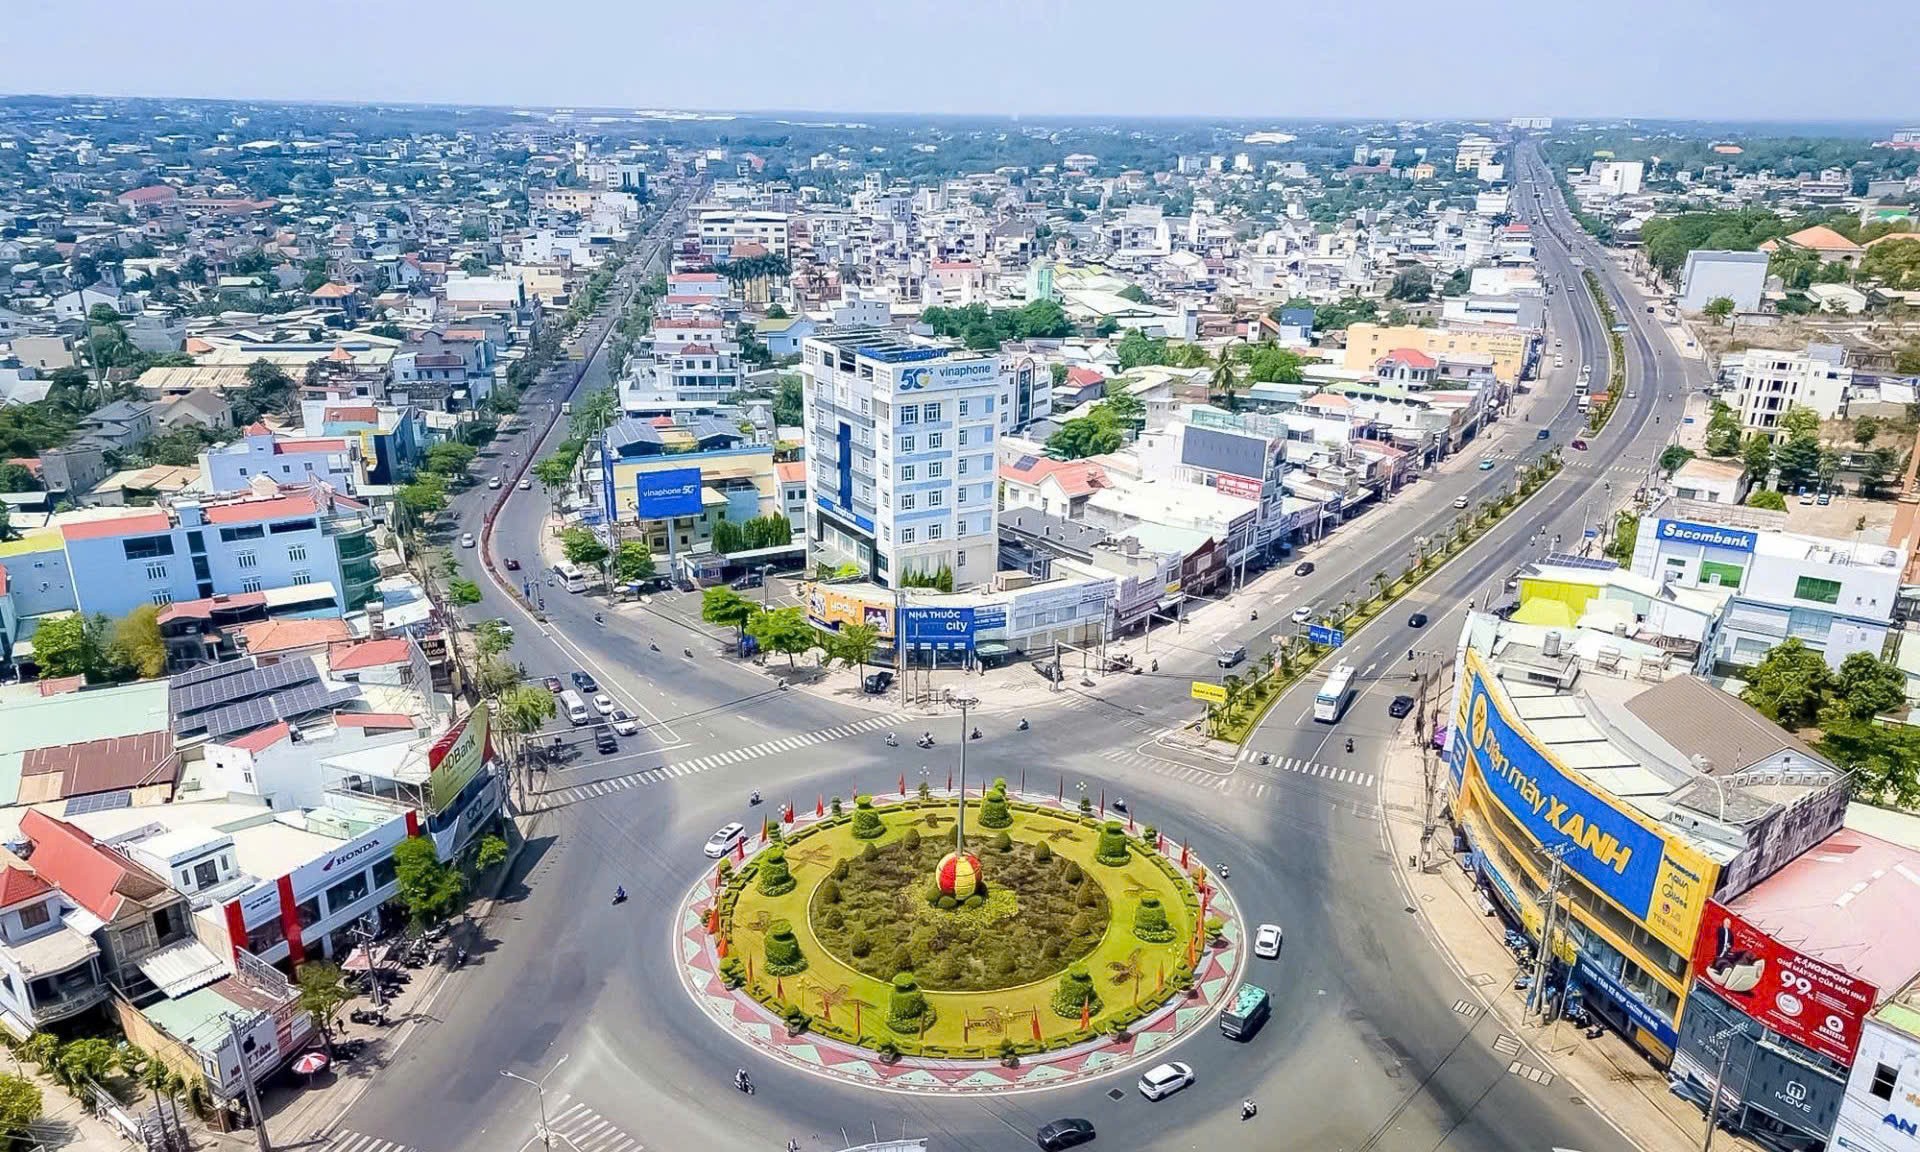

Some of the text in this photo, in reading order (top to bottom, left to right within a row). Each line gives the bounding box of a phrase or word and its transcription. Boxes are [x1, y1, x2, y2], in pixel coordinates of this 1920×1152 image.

[939, 364, 991, 377] vinaphone
[643, 487, 682, 497] vinaphone
[1663, 523, 1750, 548] Sacombank
[946, 620, 968, 633] city
[441, 734, 477, 776] HDBank
[1509, 764, 1547, 815] máy
[1545, 794, 1633, 876] XANH
[336, 839, 380, 866] HONDA
[1775, 1090, 1813, 1114] MOVE
